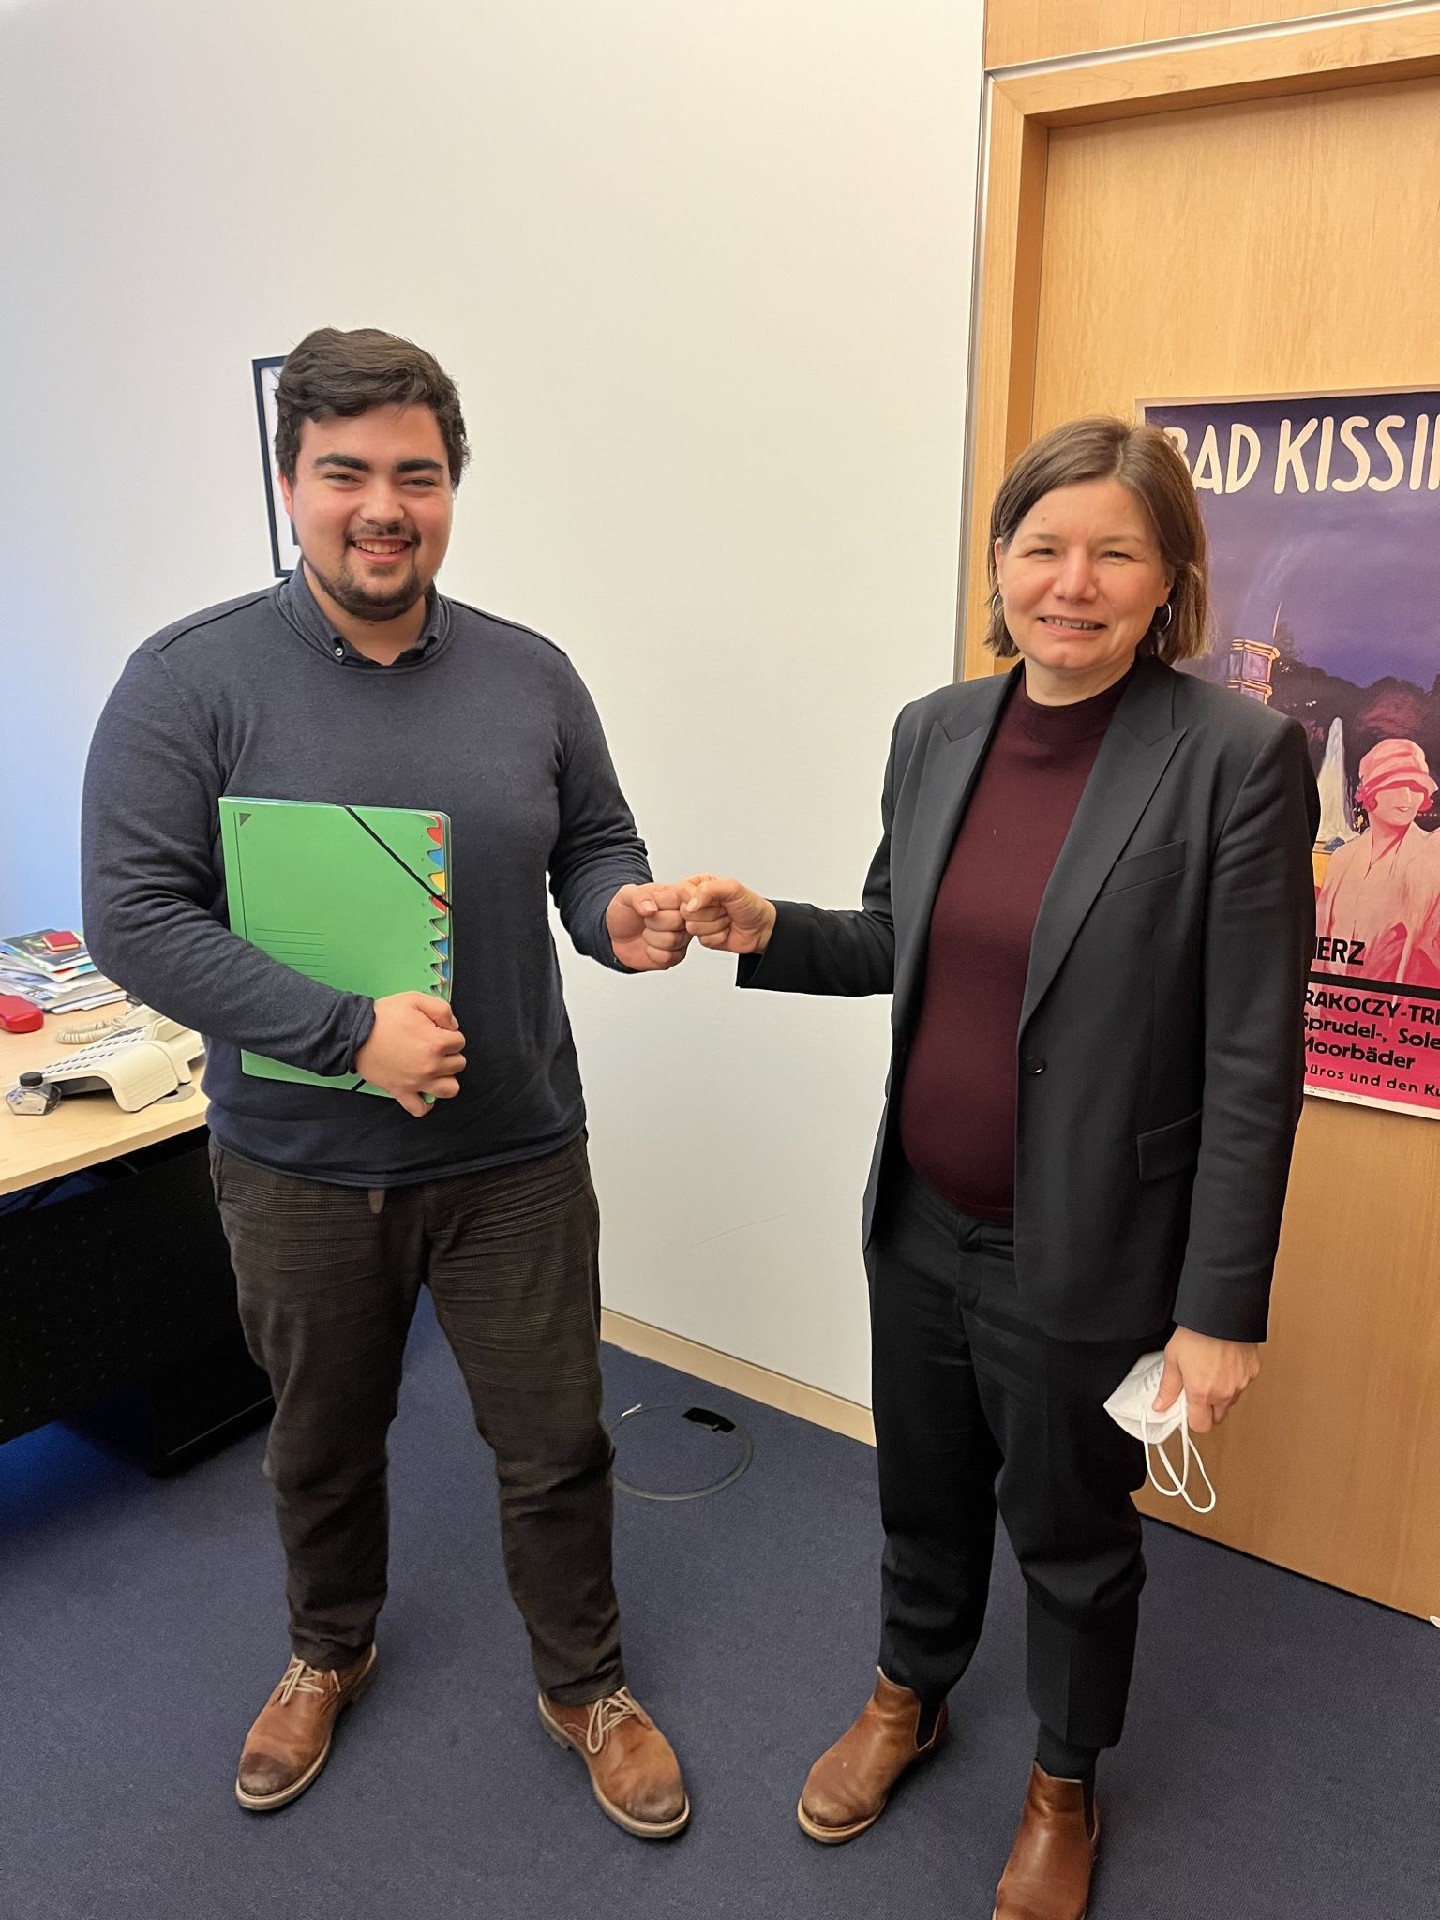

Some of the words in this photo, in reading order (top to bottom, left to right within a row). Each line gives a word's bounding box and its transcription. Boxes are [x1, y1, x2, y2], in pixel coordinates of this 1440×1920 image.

[1313, 936, 1366, 966] ERZ
[1305, 1063, 1344, 1080] üros
[1349, 1072, 1381, 1087] und
[1386, 1077, 1418, 1093] den
